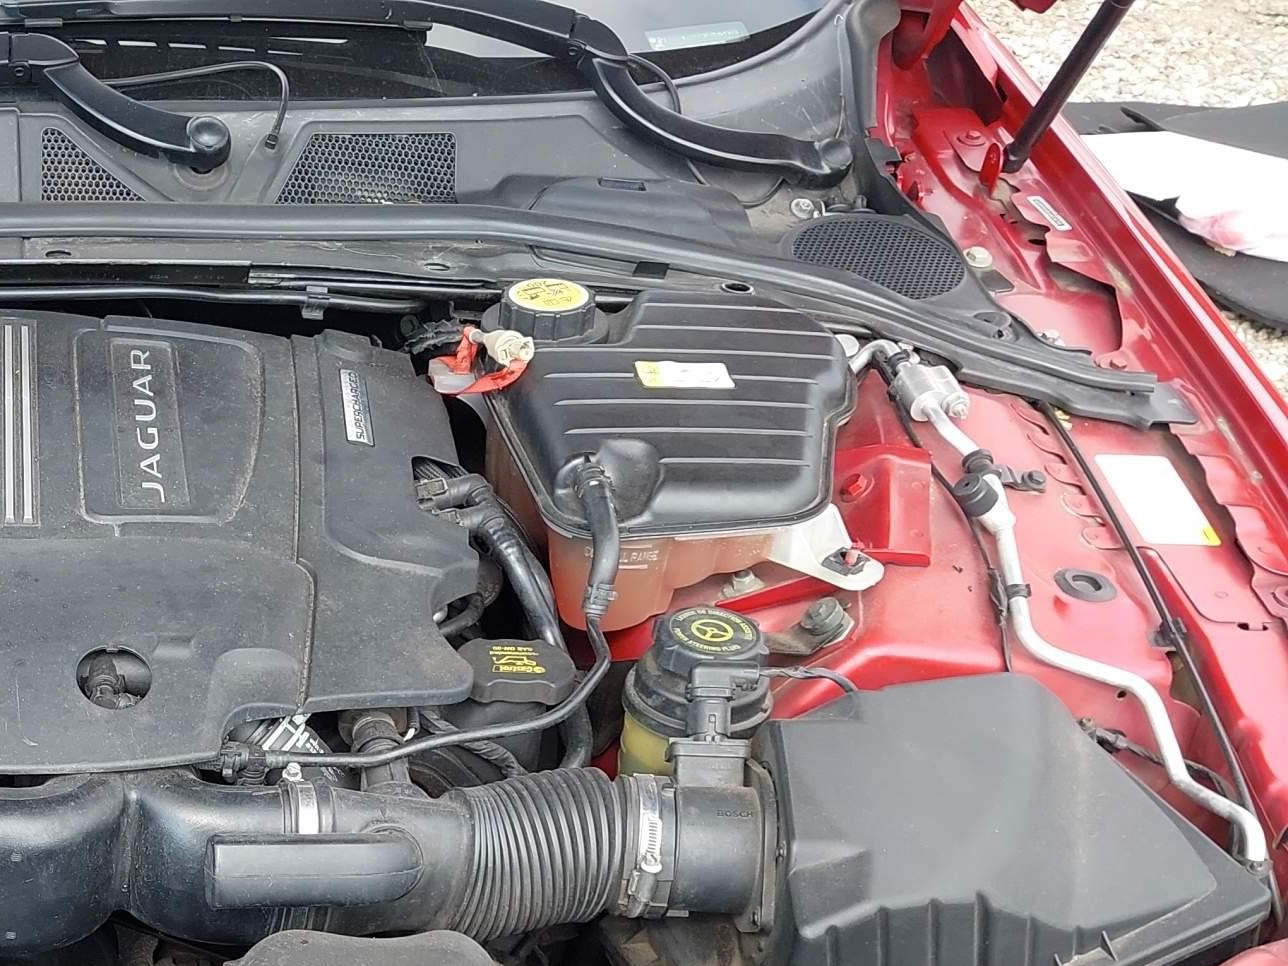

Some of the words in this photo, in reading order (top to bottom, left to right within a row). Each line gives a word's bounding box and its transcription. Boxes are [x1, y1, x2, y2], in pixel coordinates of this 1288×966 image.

[348, 371, 365, 440] SUPERCHARGED
[130, 349, 166, 503] JAGUAR
[687, 640, 721, 652] STEERING
[721, 644, 742, 652] FLUID
[499, 665, 533, 673] Castrol
[716, 809, 754, 818] BOSCH
